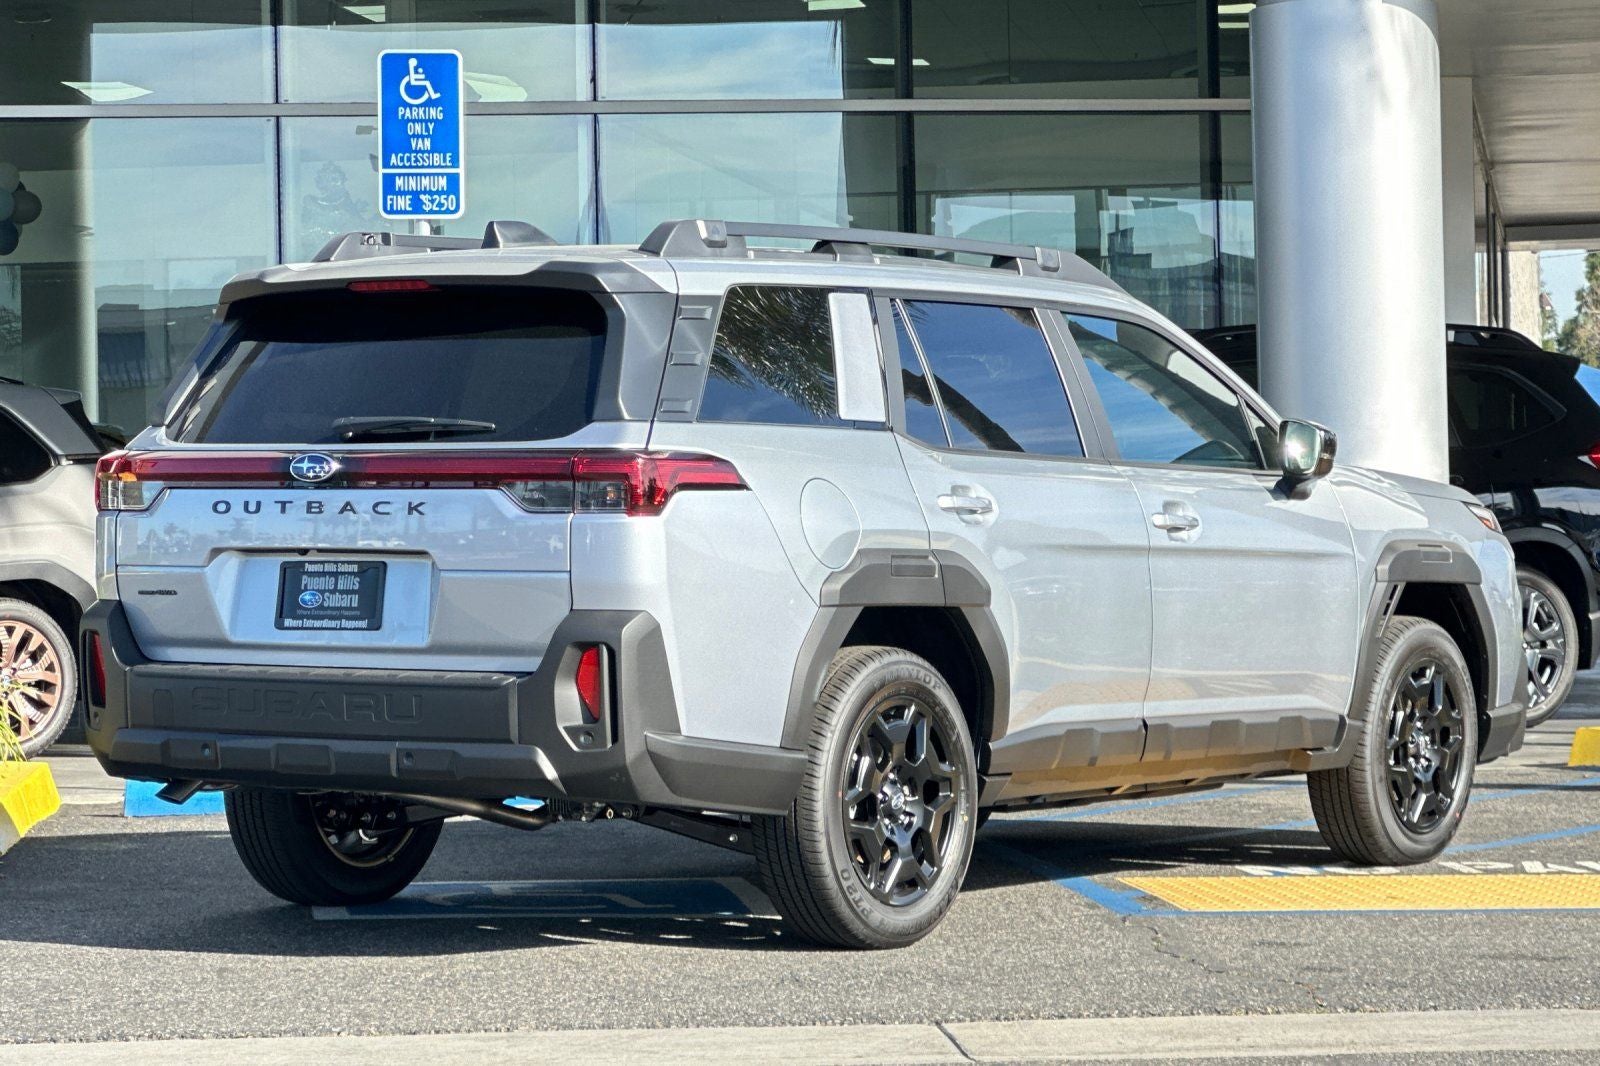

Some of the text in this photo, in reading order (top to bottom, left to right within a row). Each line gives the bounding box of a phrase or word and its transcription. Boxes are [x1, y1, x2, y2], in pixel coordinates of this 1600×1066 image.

[398, 106, 443, 120] PARKING
[407, 122, 434, 136] ONLY
[410, 138, 431, 151] VAN
[390, 153, 453, 166] ACCESSIBLE
[395, 175, 447, 192] MINIMUM
[387, 194, 456, 212] FINE $250
[211, 500, 426, 516] OUTBACK
[301, 574, 360, 590] Puente Hills
[323, 592, 359, 608] Subaru
[191, 686, 424, 724] SUBARU
